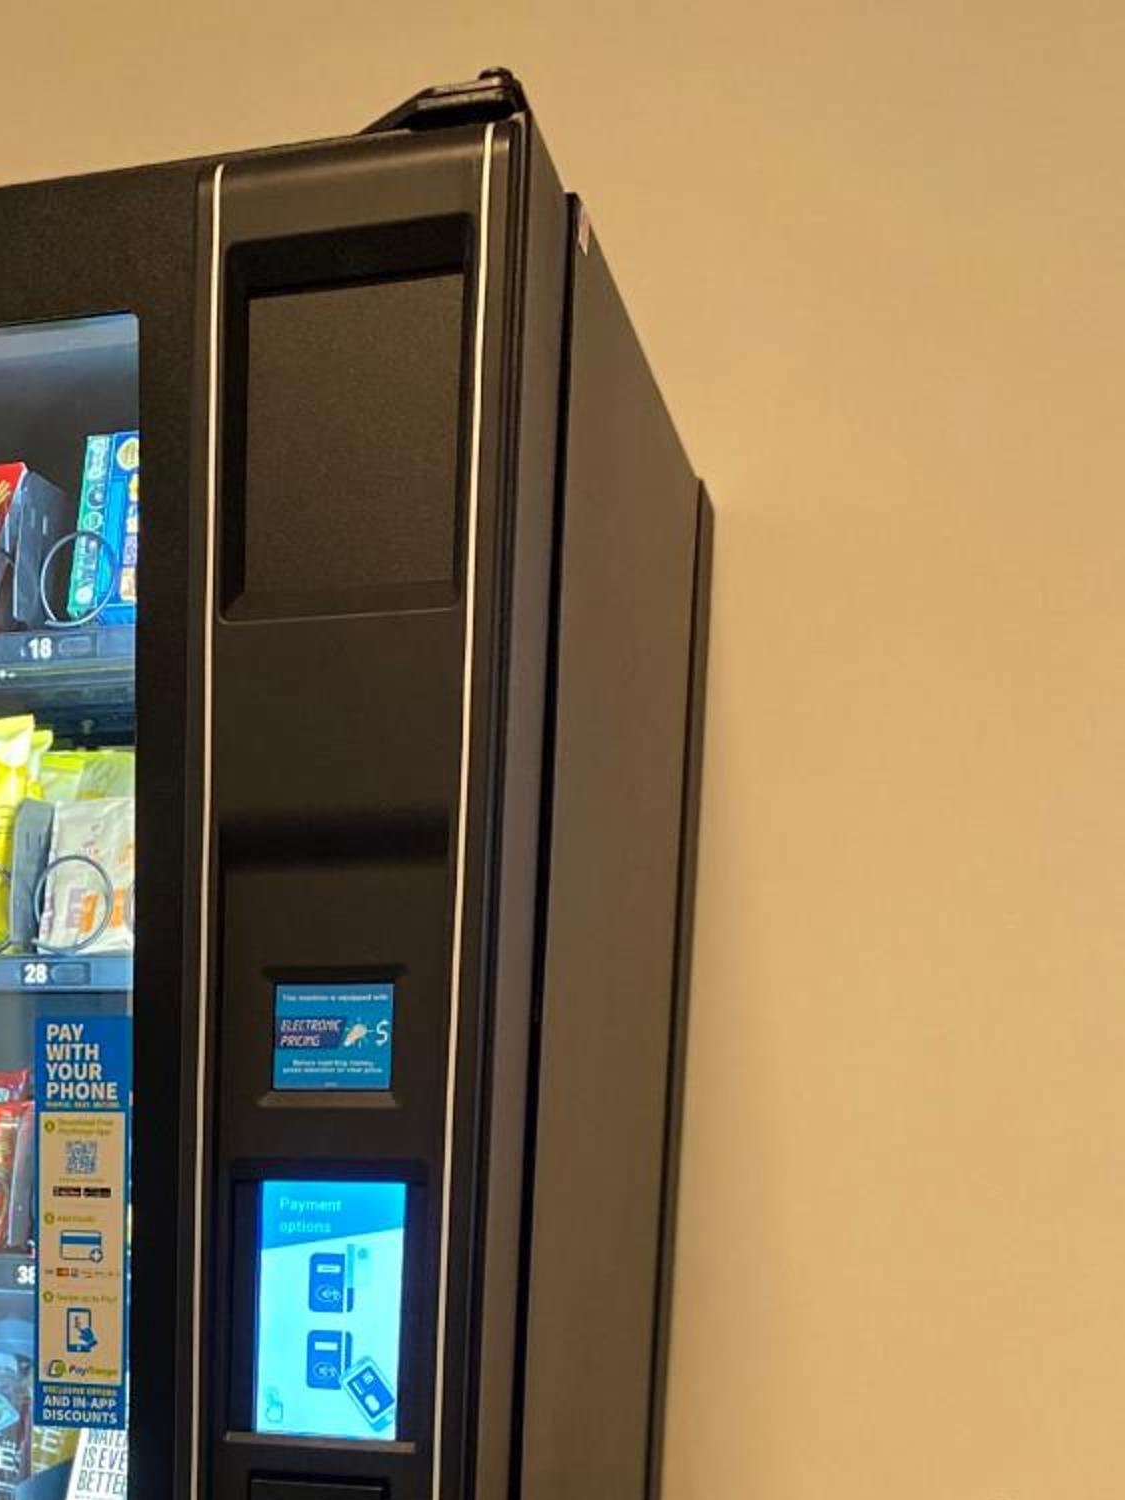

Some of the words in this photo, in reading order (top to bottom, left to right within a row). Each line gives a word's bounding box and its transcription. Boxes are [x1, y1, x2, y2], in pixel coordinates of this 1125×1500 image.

[27, 639, 53, 660] 18
[24, 966, 48, 985] 28
[46, 1023, 84, 1042] PAY
[280, 1035, 320, 1047] PRICING
[46, 1043, 100, 1062] WITH
[46, 1063, 102, 1081] YOUR
[46, 1082, 119, 1100] PHONE
[280, 1198, 342, 1213] Payment
[280, 1220, 331, 1234] options
[43, 1395, 70, 1407] AND
[43, 1409, 118, 1424] DISCOUNTS
